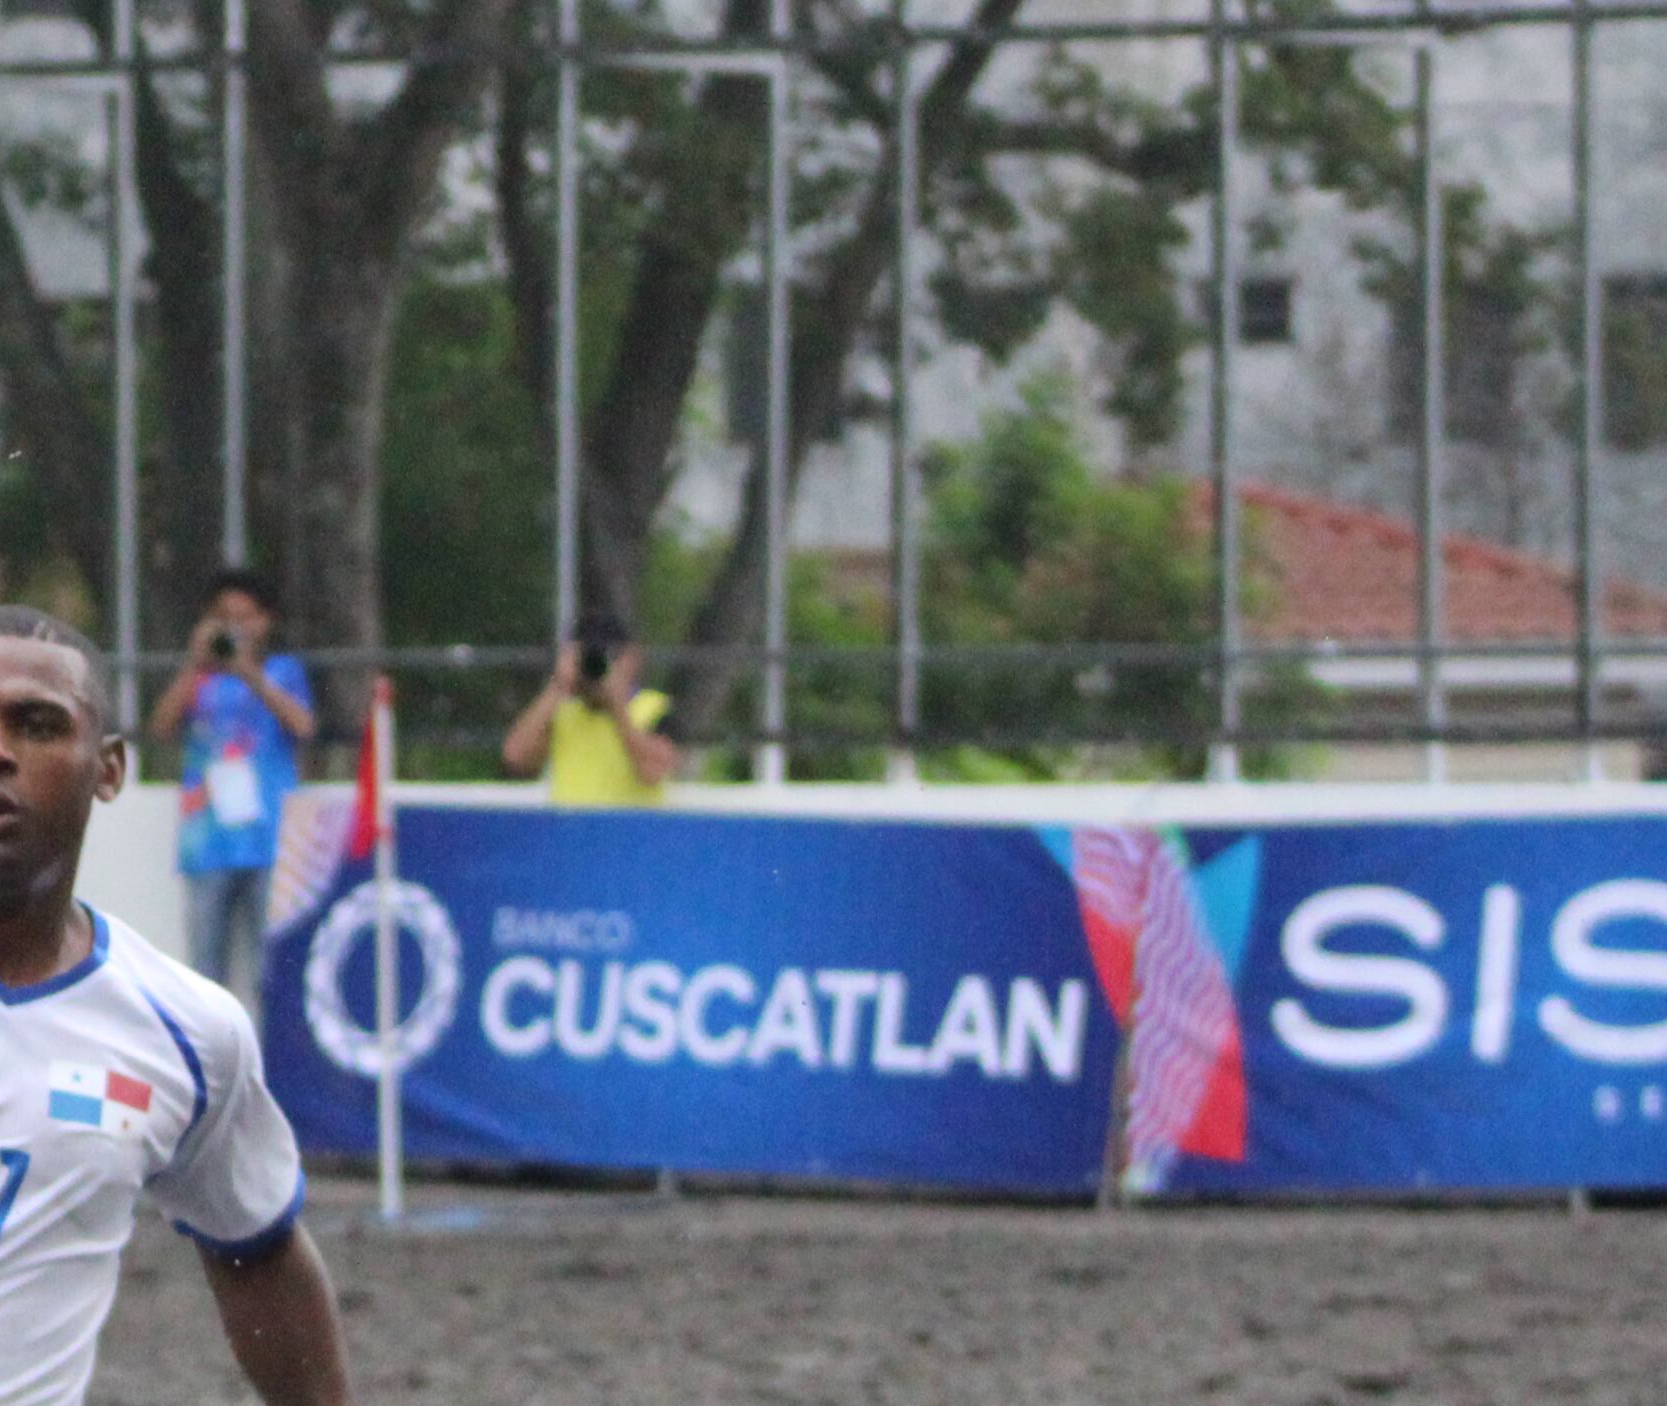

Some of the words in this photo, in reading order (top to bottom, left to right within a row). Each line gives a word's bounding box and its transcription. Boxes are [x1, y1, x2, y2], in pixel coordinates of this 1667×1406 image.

[492, 907, 632, 951] BANCO
[1271, 877, 1667, 1070] SIS
[480, 956, 1088, 1082] CUSCATLAN
